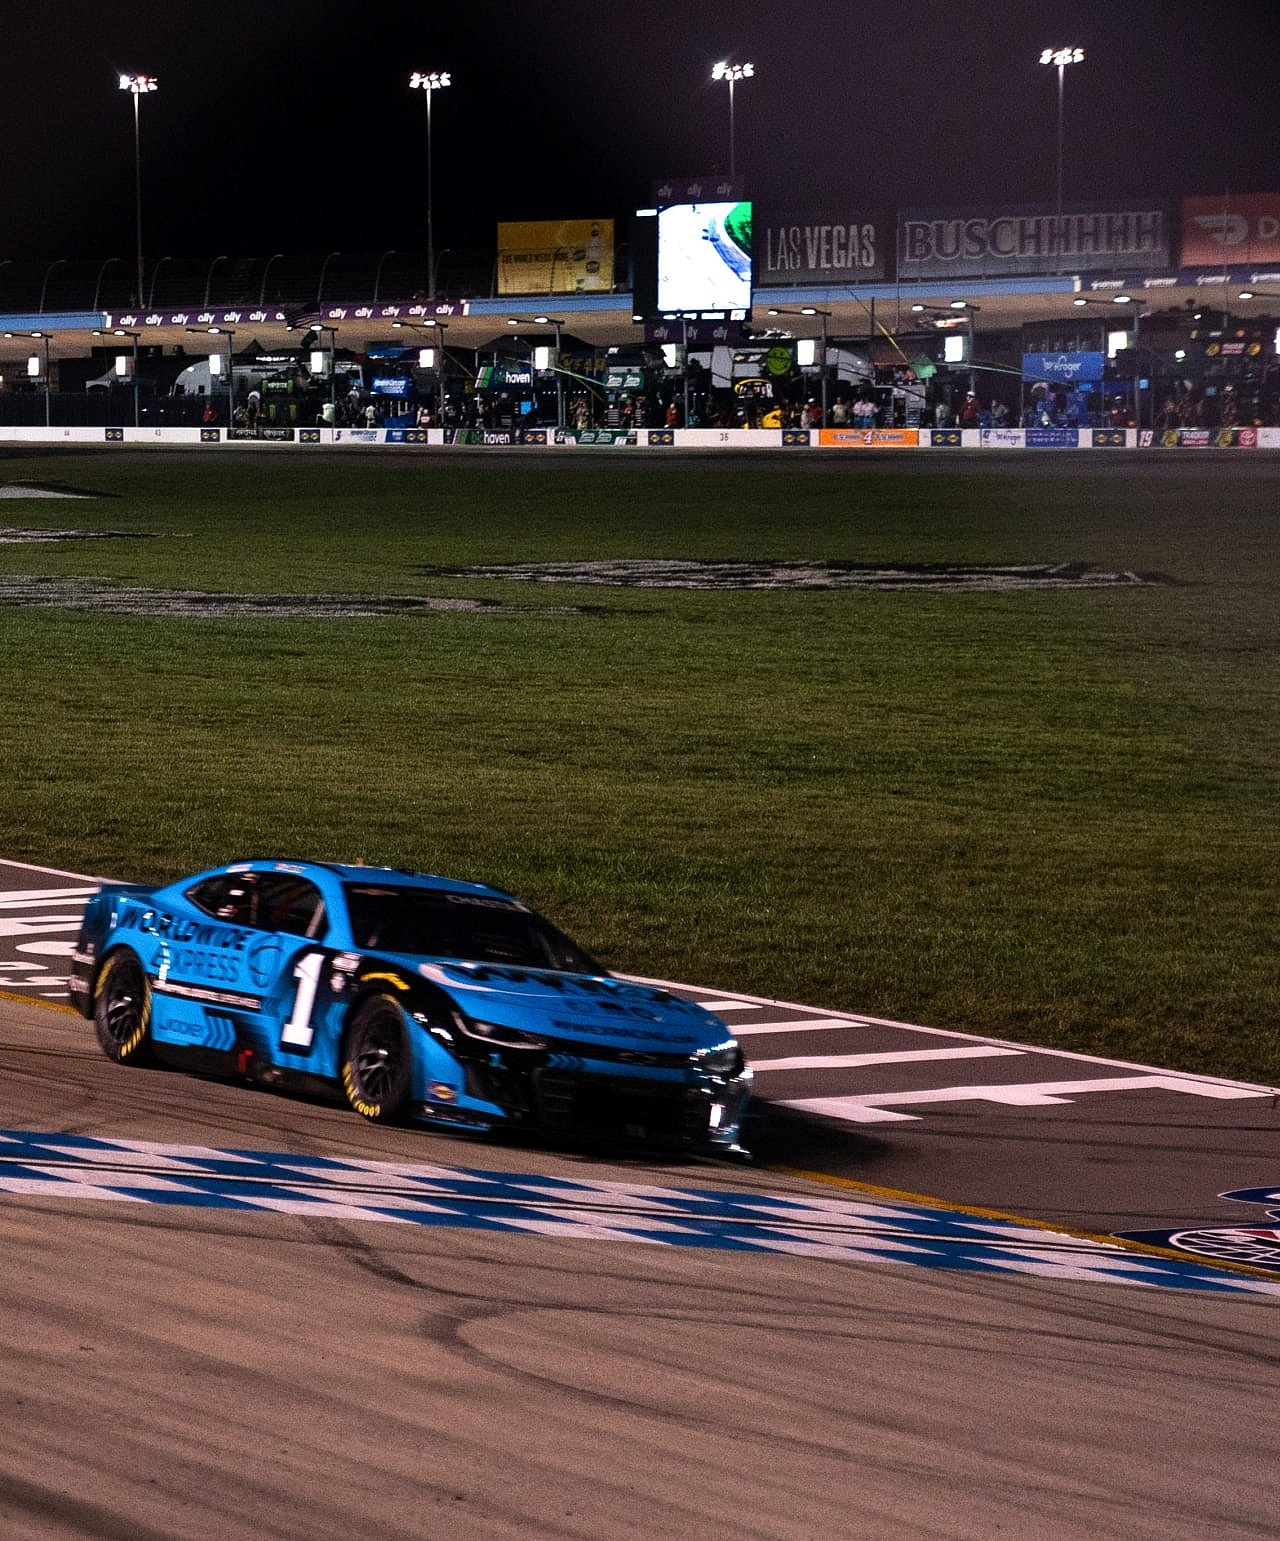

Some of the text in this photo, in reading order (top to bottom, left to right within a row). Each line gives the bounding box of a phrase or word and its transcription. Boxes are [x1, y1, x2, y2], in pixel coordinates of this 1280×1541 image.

[767, 224, 875, 271] LAS VEGAS
[120, 315, 137, 327] ally
[145, 314, 163, 326] ally
[171, 313, 189, 325] ally
[197, 312, 215, 324] ally
[223, 311, 242, 324] ally
[249, 310, 267, 323] ally
[328, 304, 454, 320] ally ally ally ally ally
[1139, 430, 1154, 447] 19
[119, 905, 256, 951] WORLDWIDE
[281, 952, 326, 1047] 1
